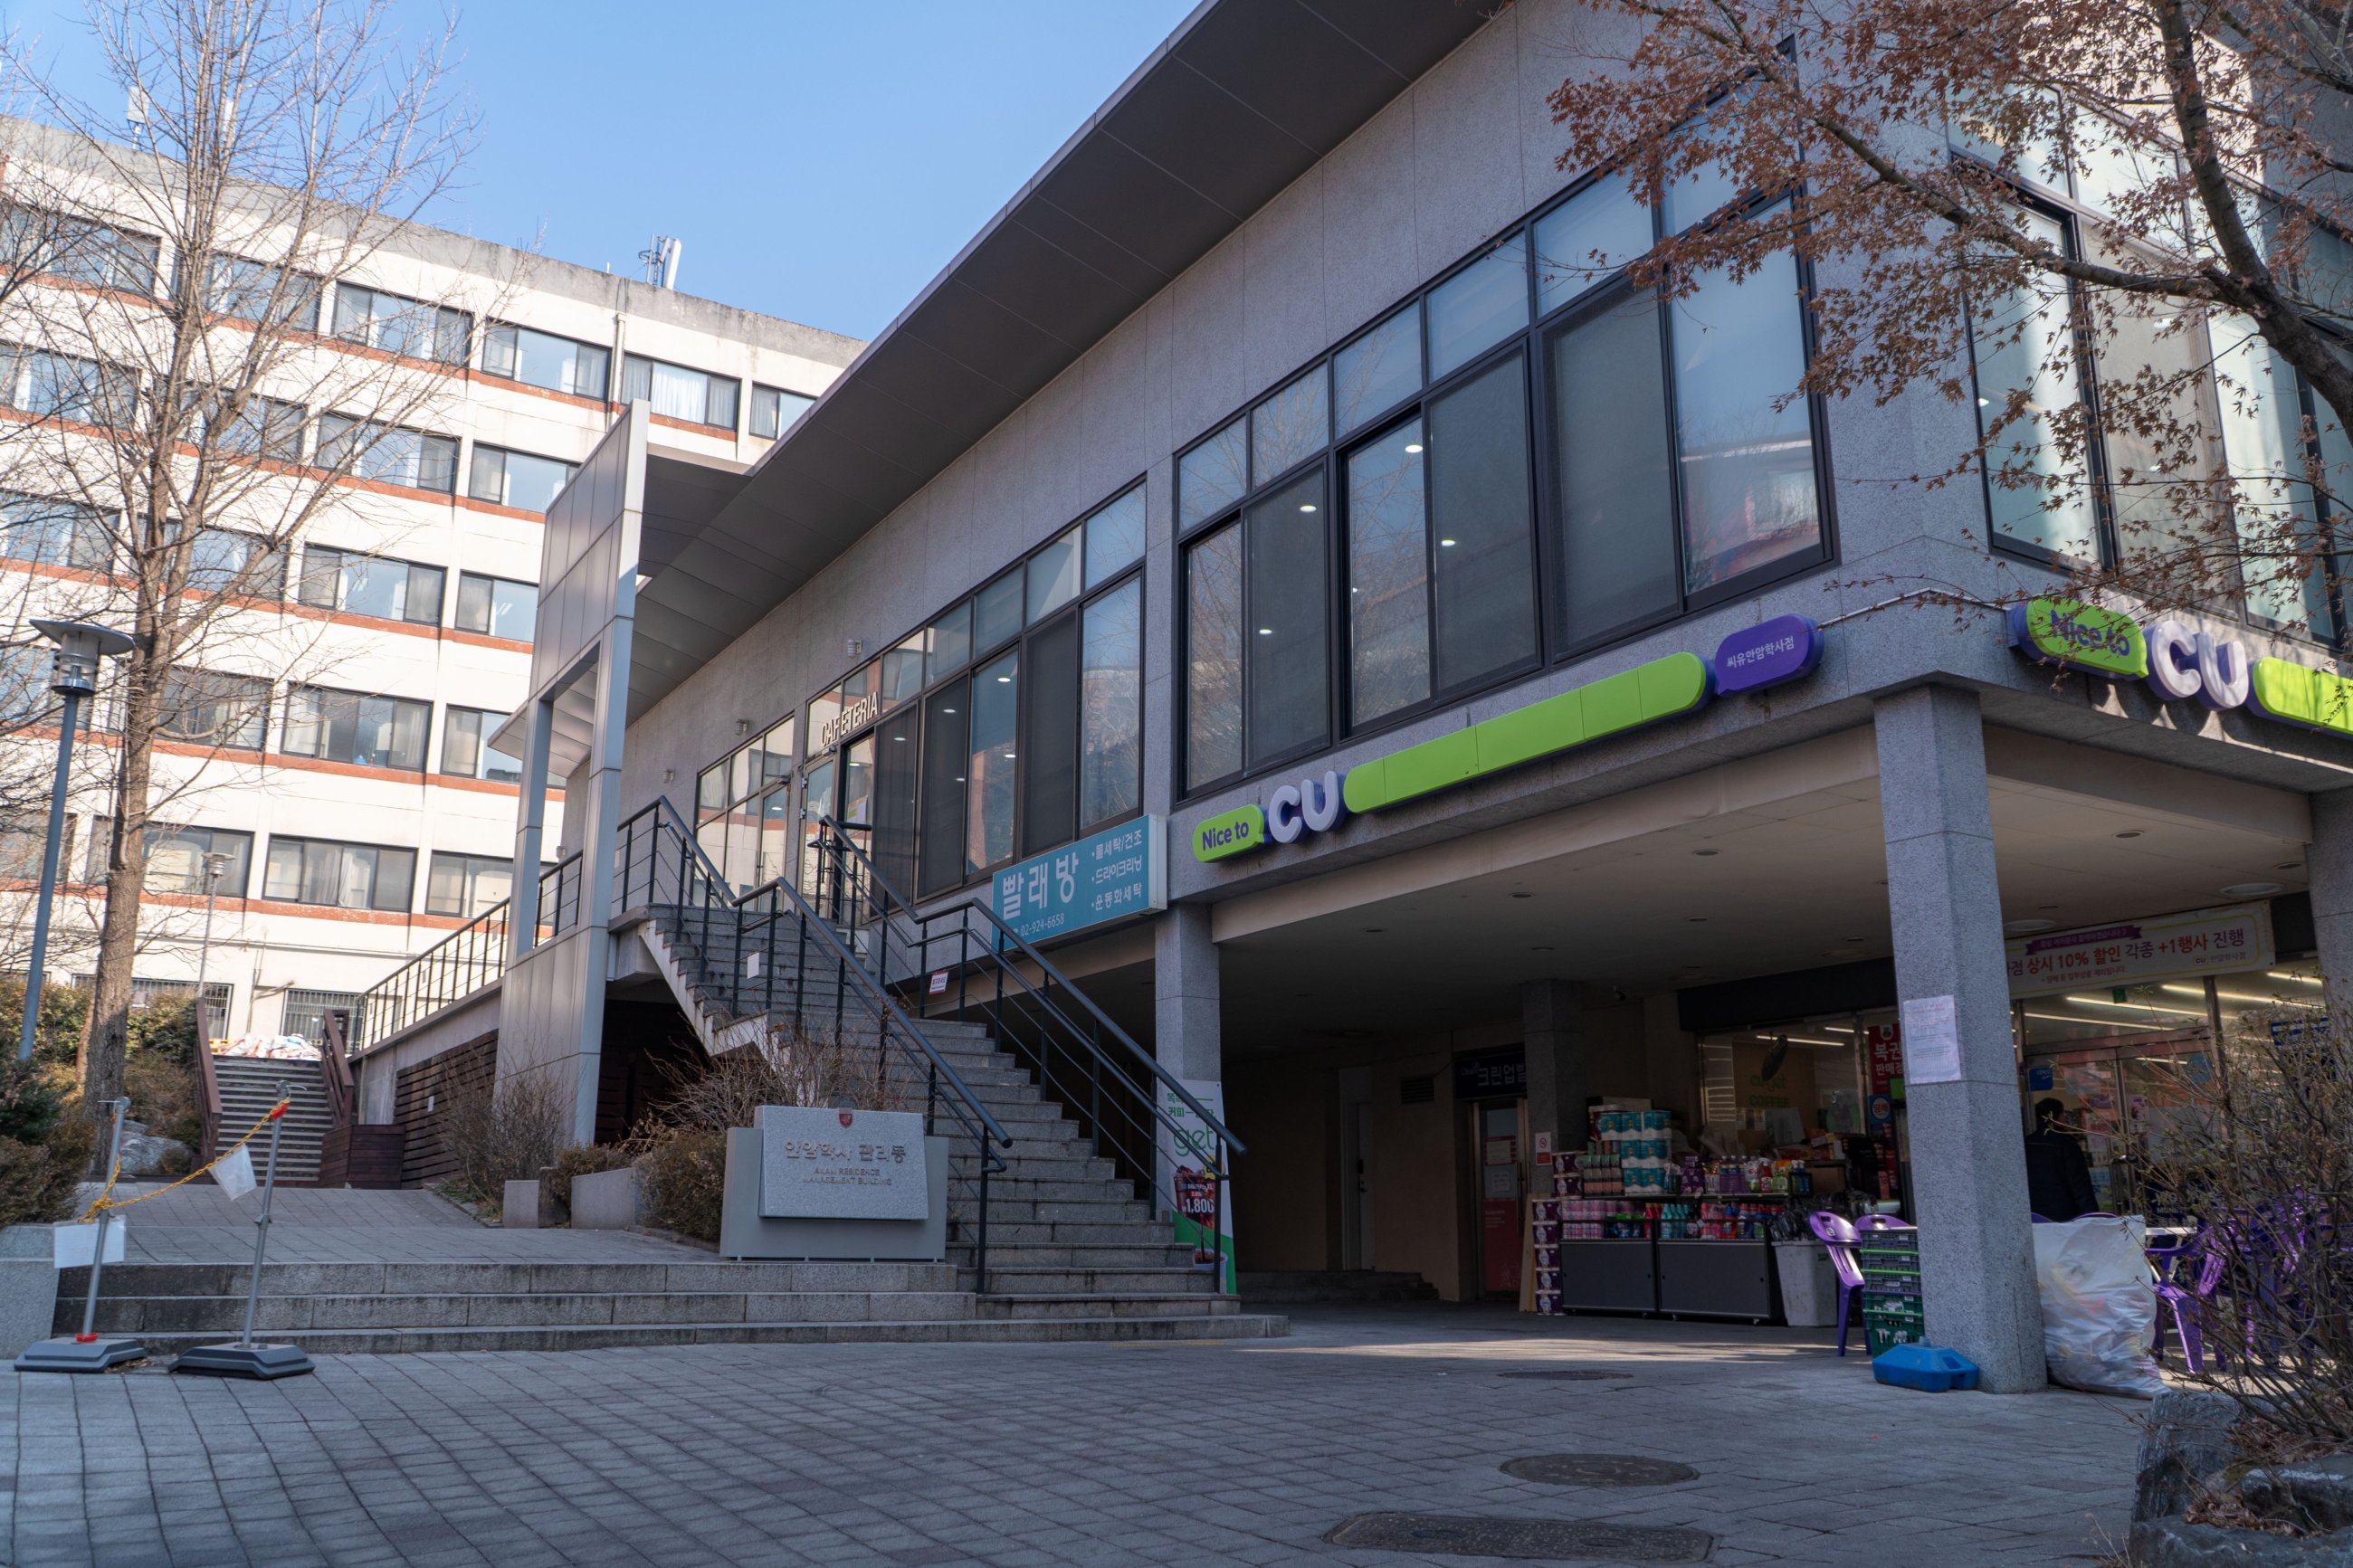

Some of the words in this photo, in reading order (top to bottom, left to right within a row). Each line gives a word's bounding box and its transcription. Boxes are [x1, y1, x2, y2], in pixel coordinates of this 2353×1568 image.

[2051, 609, 2102, 649] Nice
[2107, 626, 2130, 657] to
[1727, 635, 1795, 668] 씨유안암학사점
[2149, 621, 2249, 708] CU
[820, 691, 879, 747] CAFETERIA
[1268, 771, 1339, 844] CU
[1202, 824, 1232, 851] Nice
[1234, 821, 1250, 842] to
[1095, 854, 1143, 885] 드라이크리닝
[1002, 851, 1080, 921] 빨래방
[1095, 882, 1143, 912] 운동화세탁
[1020, 913, 1065, 936] 02-924-6658
[2006, 960, 2024, 977] 점
[2027, 955, 2053, 974] 상시
[2057, 951, 2089, 969] 10%
[2093, 946, 2121, 965] 할인
[2125, 941, 2154, 960] 각종
[2213, 928, 2244, 949] 진행
[1875, 1061, 1903, 1077] 판매점
[1168, 1107, 1185, 1117] 커피
[785, 1142, 853, 1161] 안암학사
[858, 1144, 907, 1164] 관리동
[857, 1177, 892, 1186] BUILDING
